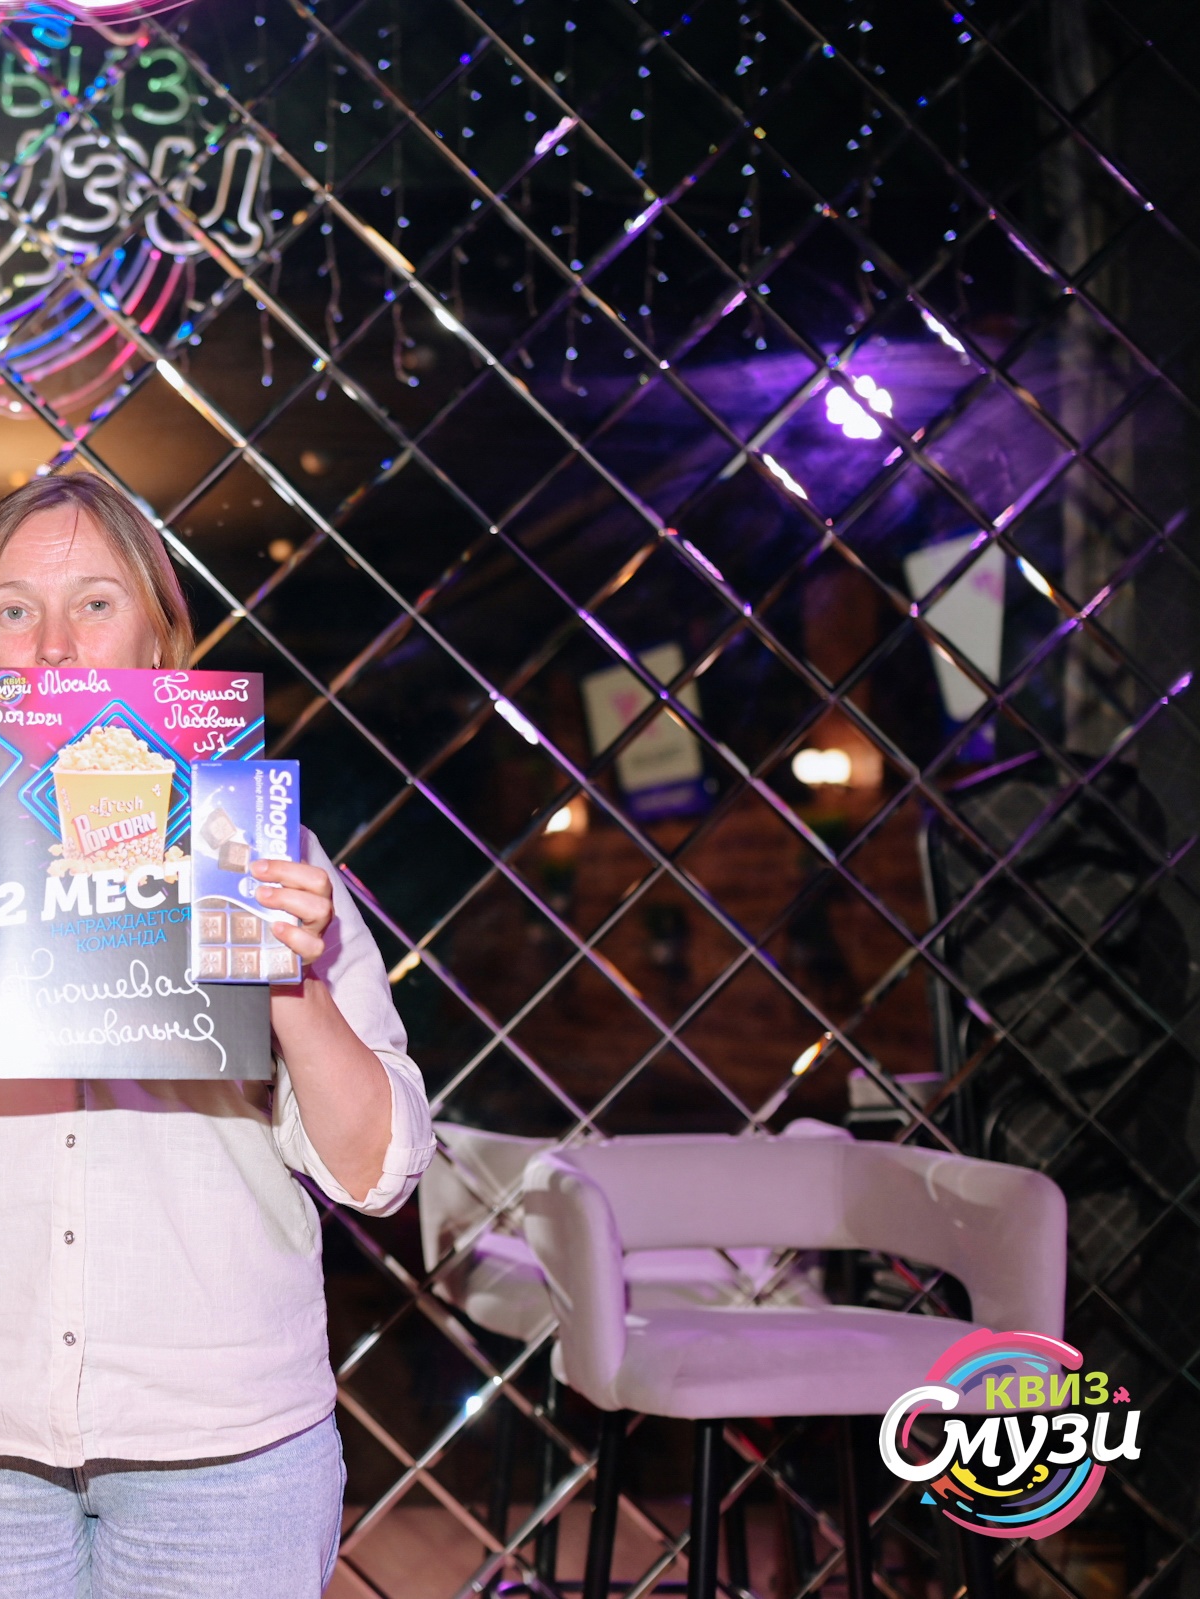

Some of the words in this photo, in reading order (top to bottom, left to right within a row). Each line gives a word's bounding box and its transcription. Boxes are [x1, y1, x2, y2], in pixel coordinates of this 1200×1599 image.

[3, 677, 26, 685] КВИЗ
[38, 669, 111, 695] Москва
[152, 672, 249, 703] Большой
[164, 704, 246, 729] Лебовски
[253, 769, 264, 794] Alpine
[255, 795, 264, 813] Milk
[263, 768, 293, 861] Schoget
[41, 860, 191, 921] МЕСТ
[50, 906, 191, 938] НАГРАЖДАЕТСЯ
[76, 928, 167, 953] КОМАНДА
